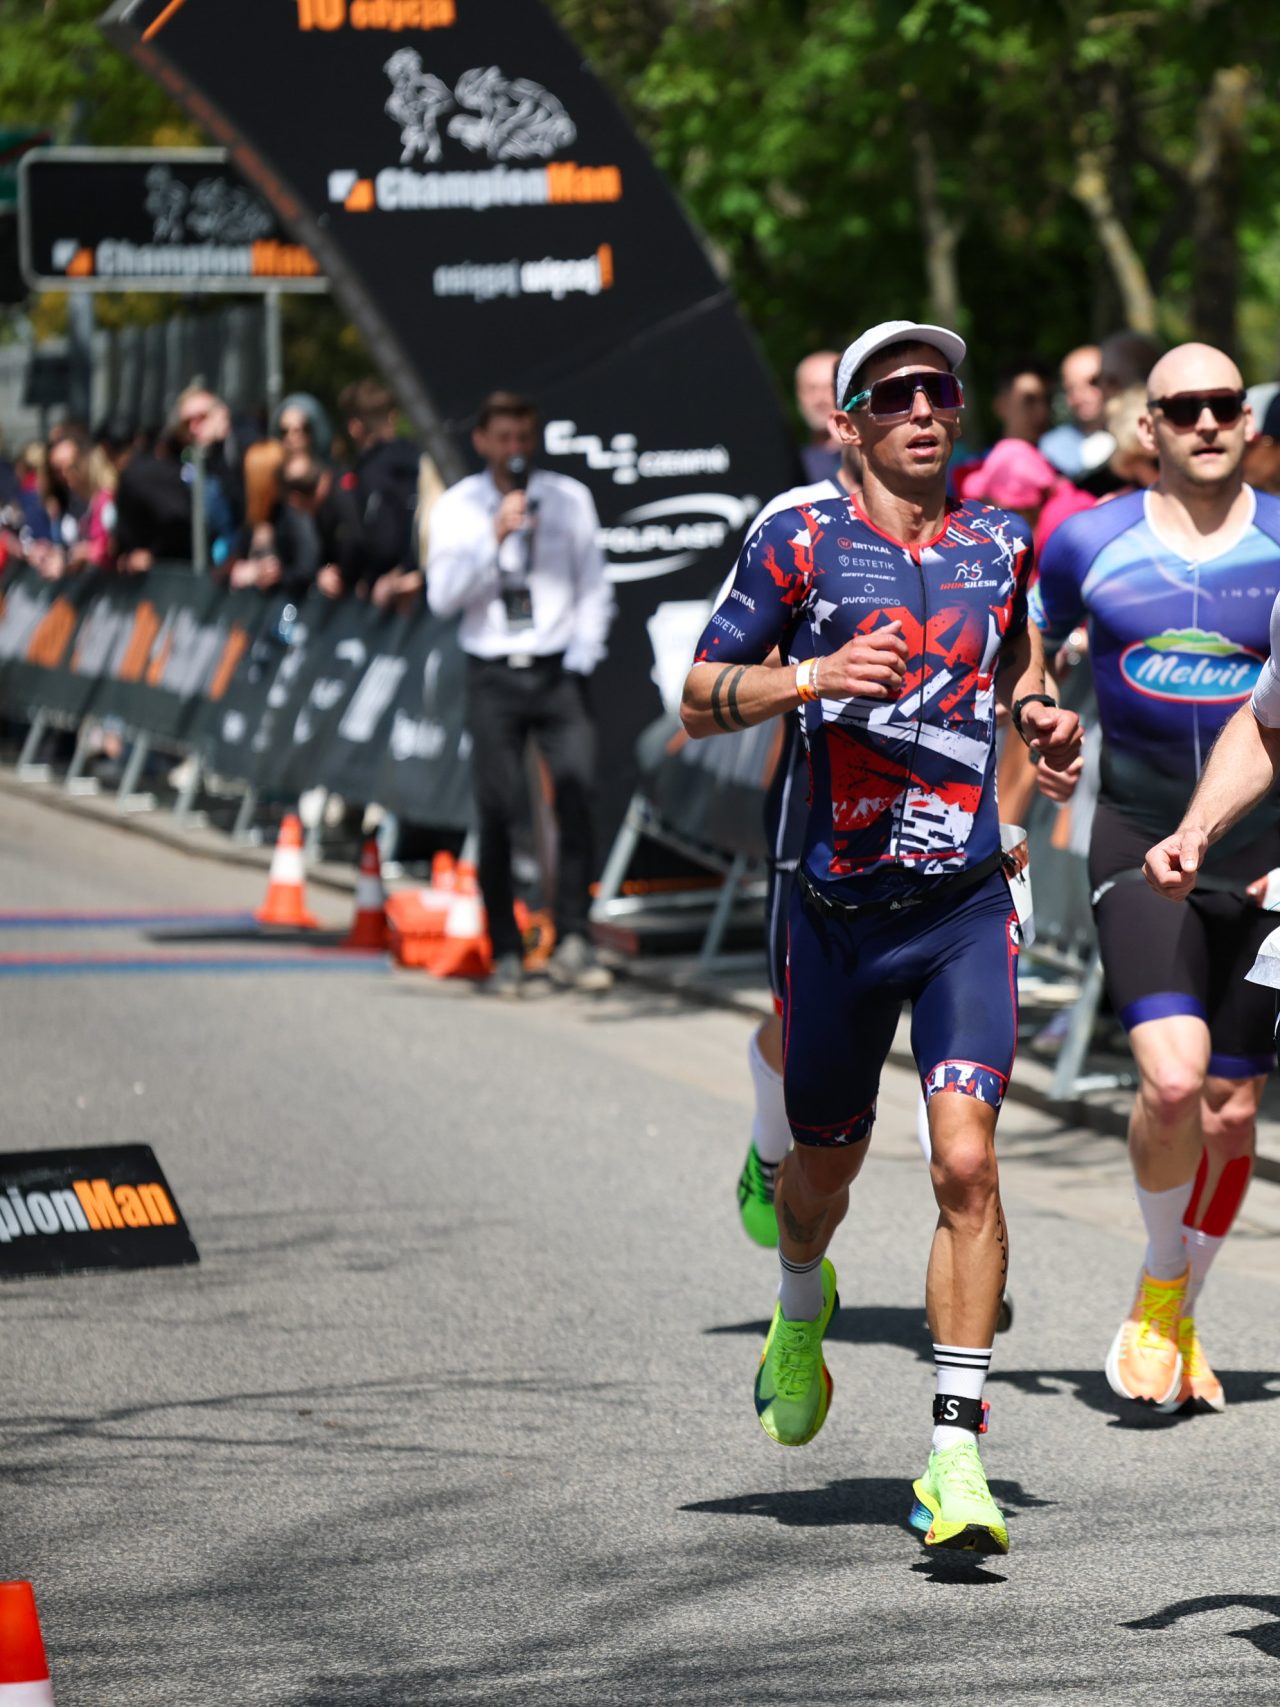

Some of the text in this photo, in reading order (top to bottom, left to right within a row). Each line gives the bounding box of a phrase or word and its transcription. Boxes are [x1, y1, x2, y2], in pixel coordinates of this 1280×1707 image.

[376, 163, 622, 211] ChampionMan
[852, 557, 895, 570] ESTETIK
[1136, 653, 1250, 688] Melvit
